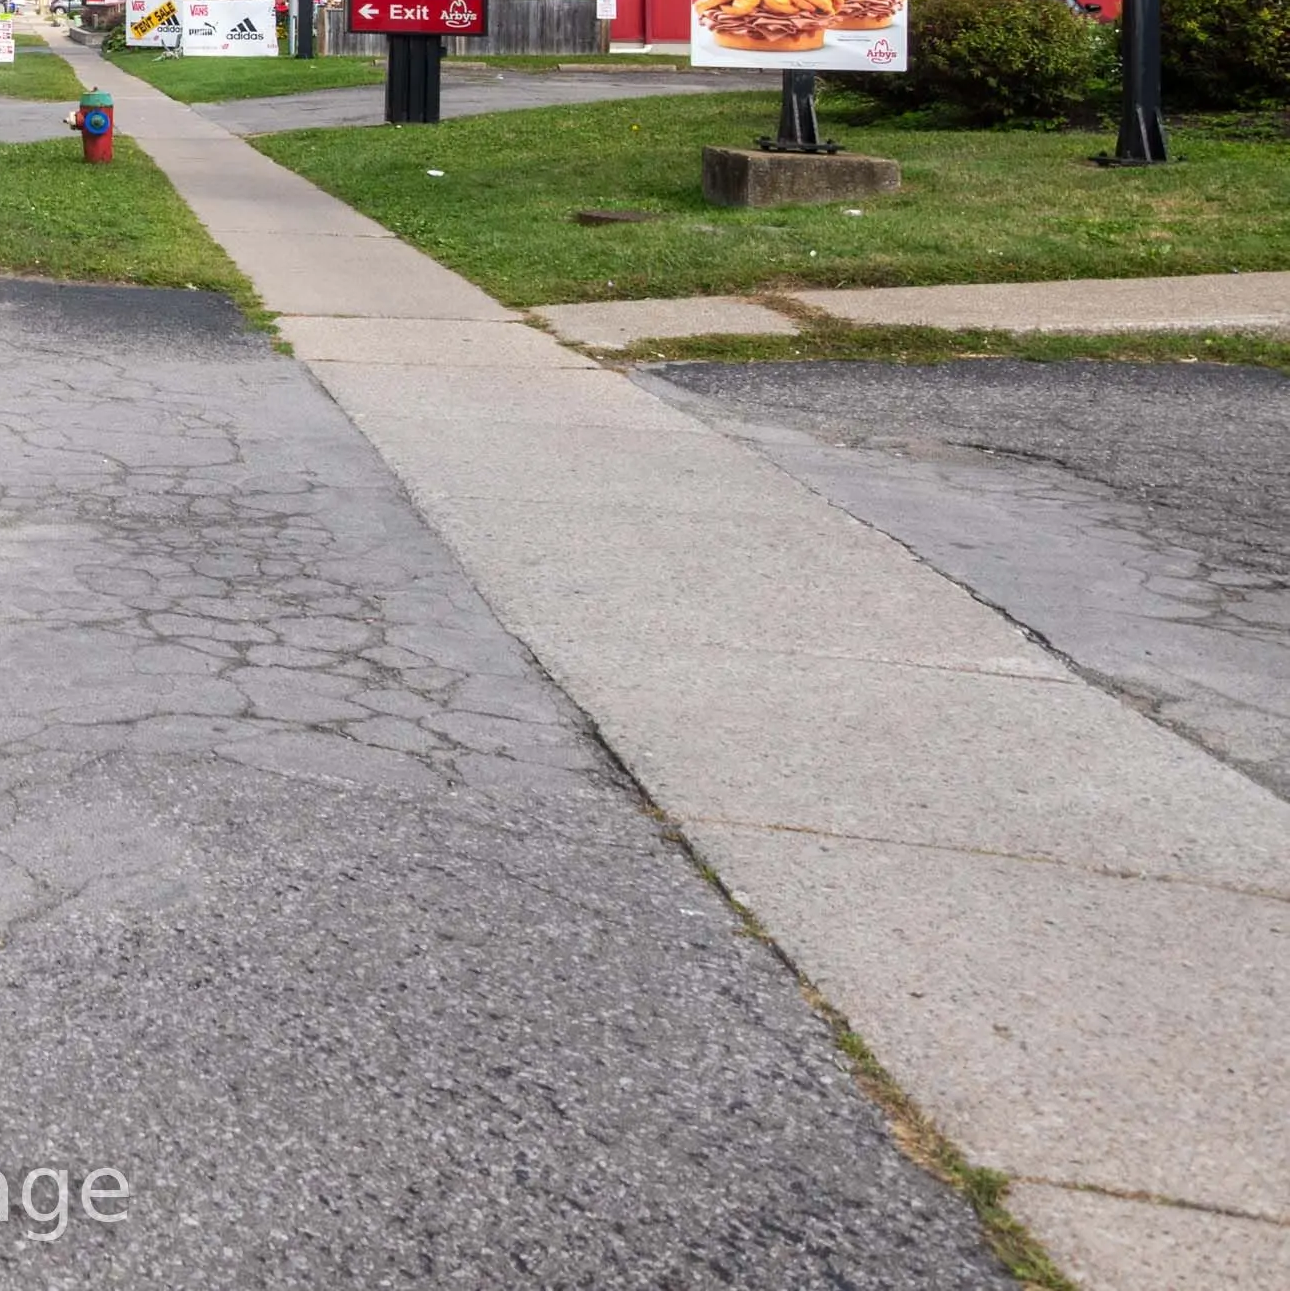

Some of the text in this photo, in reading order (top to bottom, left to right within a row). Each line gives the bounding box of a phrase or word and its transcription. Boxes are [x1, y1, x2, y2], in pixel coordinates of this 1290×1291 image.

[190, 4, 209, 16] VANS
[390, 4, 477, 21] Exit Arby's
[133, 1, 176, 37] TENT SALE
[226, 32, 264, 41] adidas
